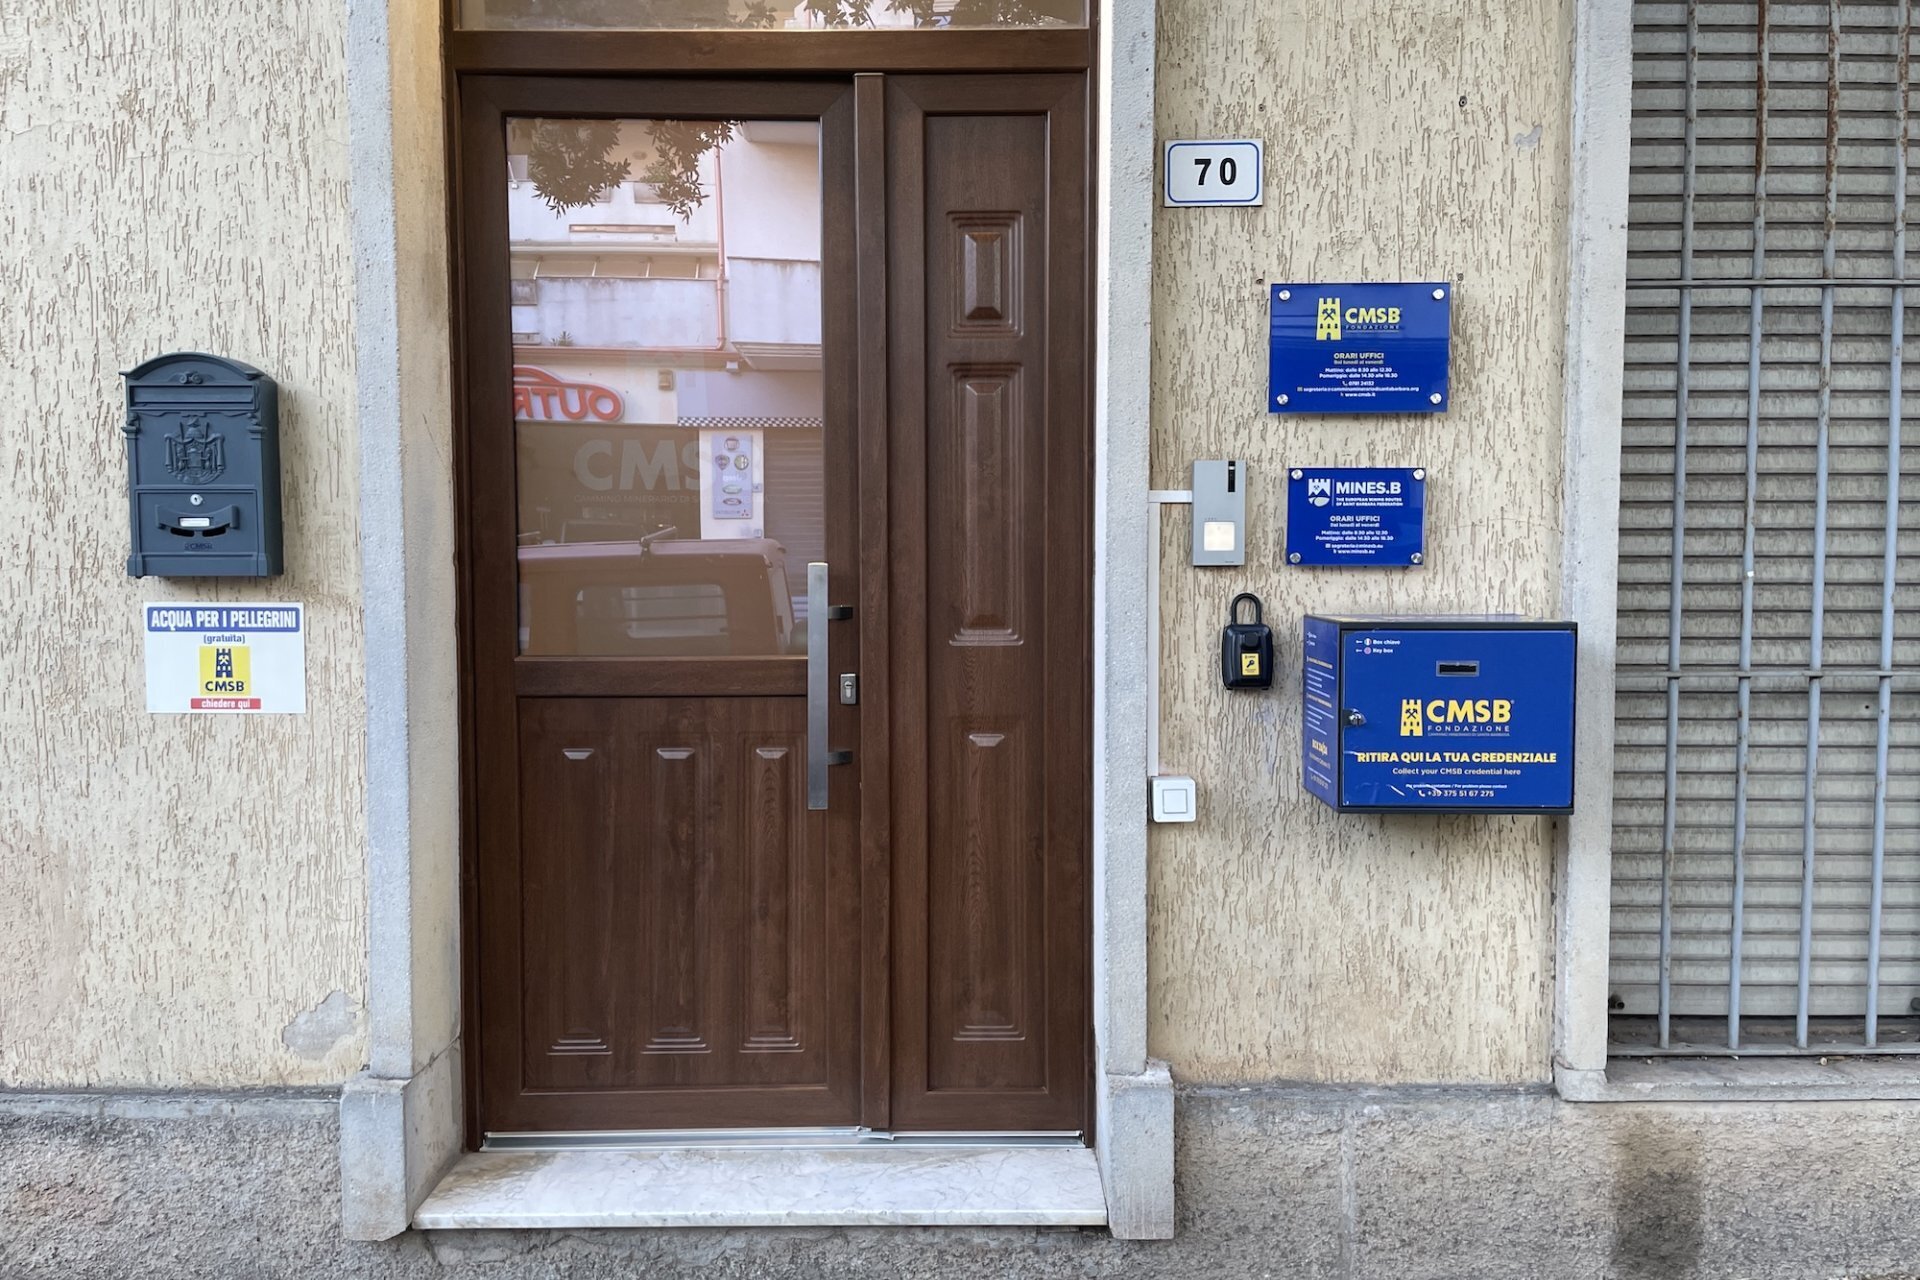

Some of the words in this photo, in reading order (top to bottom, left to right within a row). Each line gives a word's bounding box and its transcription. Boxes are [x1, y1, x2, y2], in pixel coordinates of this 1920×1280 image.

[1194, 157, 1236, 186] 70
[1345, 308, 1400, 323] CMSB
[573, 439, 717, 491] CMS
[1336, 482, 1402, 494] MINES.B
[151, 610, 193, 631] ACQUA
[196, 610, 220, 628] PER
[223, 610, 227, 628] I
[231, 610, 296, 628] PELLEGRINI
[203, 634, 245, 644] (gratuita)
[205, 681, 244, 692] CMSB
[201, 699, 235, 708] chiedere
[238, 700, 250, 710] qui
[1426, 700, 1511, 722] CMSB
[1357, 752, 1399, 762] RITIRA
[1401, 752, 1423, 763] QUI
[1425, 753, 1442, 762] LA
[1443, 753, 1469, 763] TUA
[1472, 753, 1557, 763] CREDENZIALE
[1393, 767, 1418, 775] Collect
